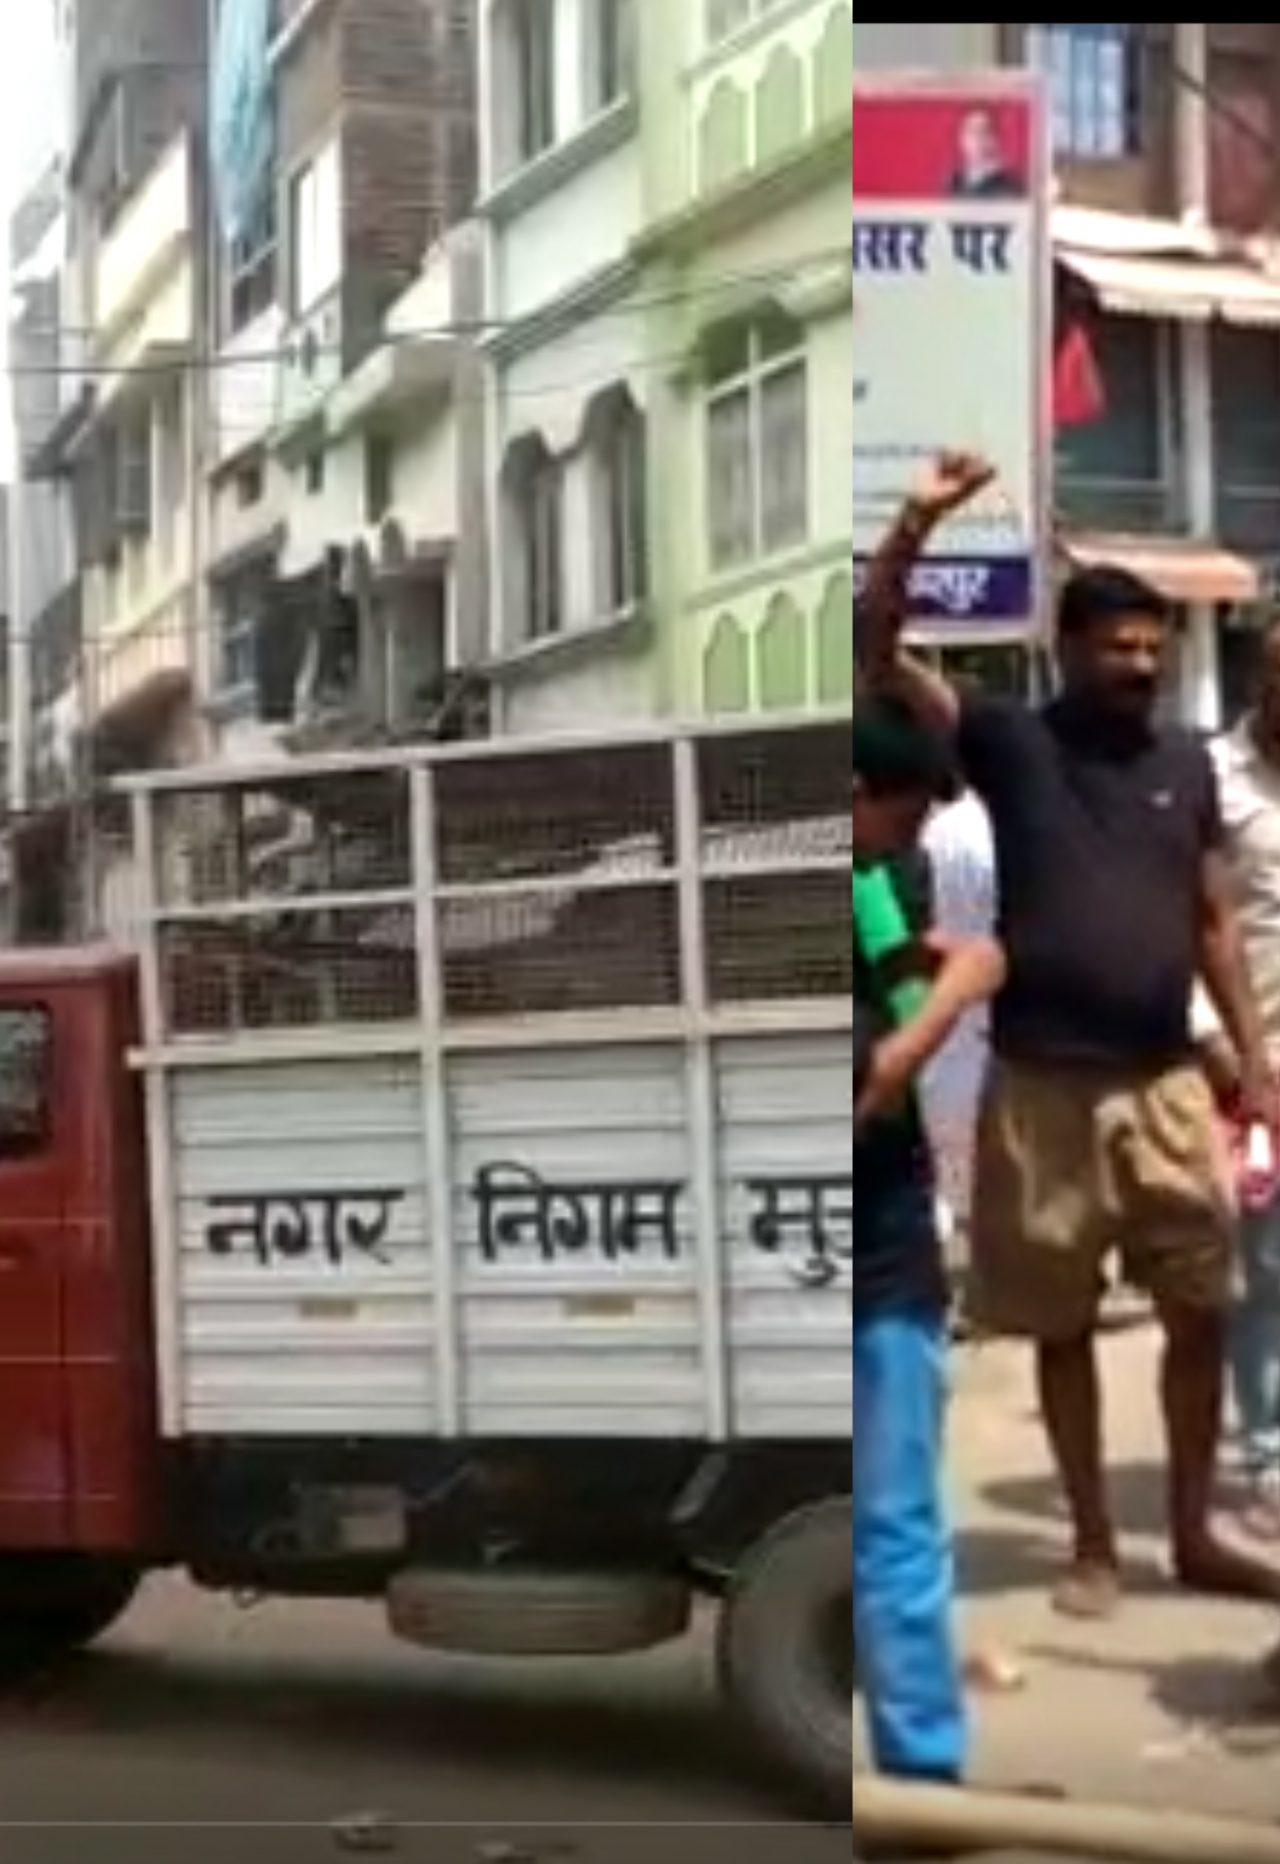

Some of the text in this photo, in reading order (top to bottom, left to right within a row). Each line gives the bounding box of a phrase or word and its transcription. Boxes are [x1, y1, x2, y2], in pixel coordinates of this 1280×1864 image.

[948, 221, 1014, 273] पर
[203, 1189, 404, 1264] नगर
[472, 1160, 690, 1260] निगम
